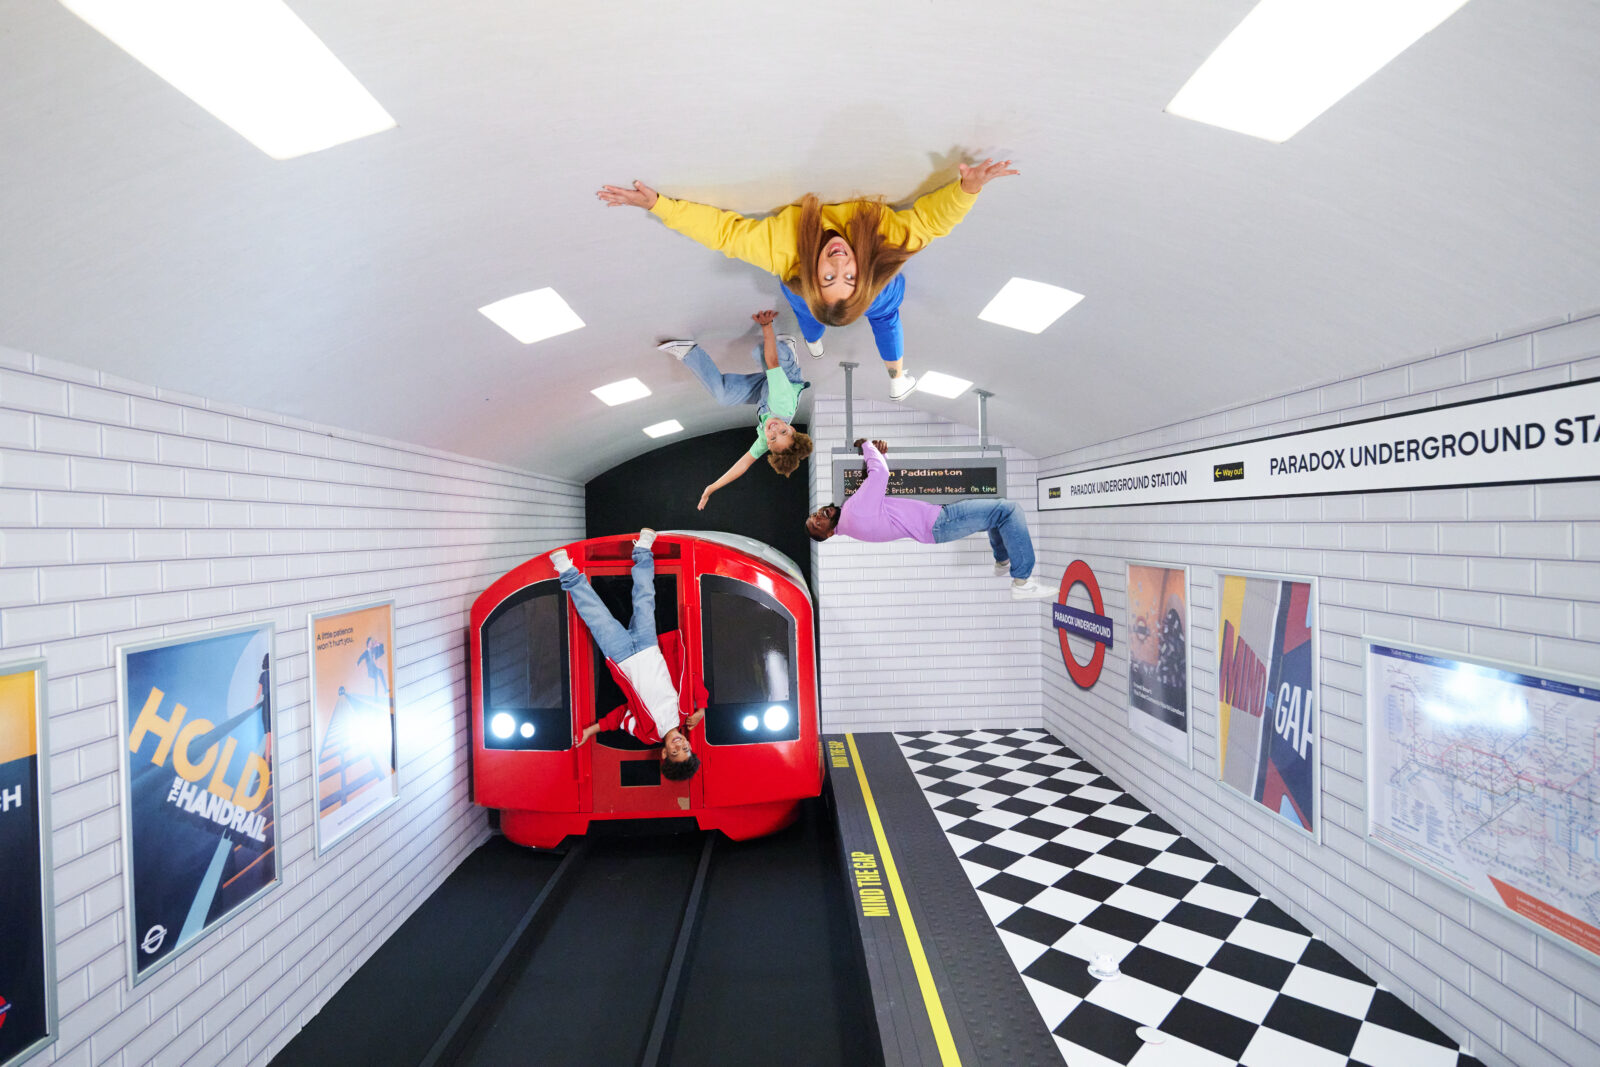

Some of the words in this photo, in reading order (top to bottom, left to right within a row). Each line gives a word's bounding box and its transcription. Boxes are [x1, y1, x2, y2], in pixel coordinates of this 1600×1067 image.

[1269, 448, 1346, 476] PARADOX
[1350, 422, 1546, 467] UNDERGROUND
[1554, 414, 1600, 447] ST
[900, 469, 963, 477] Paddington
[1070, 485, 1096, 496] PARADOX
[1096, 475, 1150, 493] UNDERGROUND
[1151, 470, 1188, 488] STATION
[1222, 469, 1233, 478] Way
[1233, 467, 1243, 476] out
[321, 631, 333, 640] little
[333, 627, 353, 637] patience
[1054, 611, 1075, 627] PARADOX
[1074, 618, 1112, 639] UNDERGROUND
[317, 641, 332, 650] won't
[333, 639, 343, 647] hurt
[1219, 619, 1267, 719] MIND
[128, 686, 271, 812] HOLD
[166, 776, 186, 803] THE
[175, 780, 268, 843] HANDRAIL
[850, 851, 878, 869] GAP
[854, 869, 883, 888] THE
[858, 888, 891, 917] MIND
